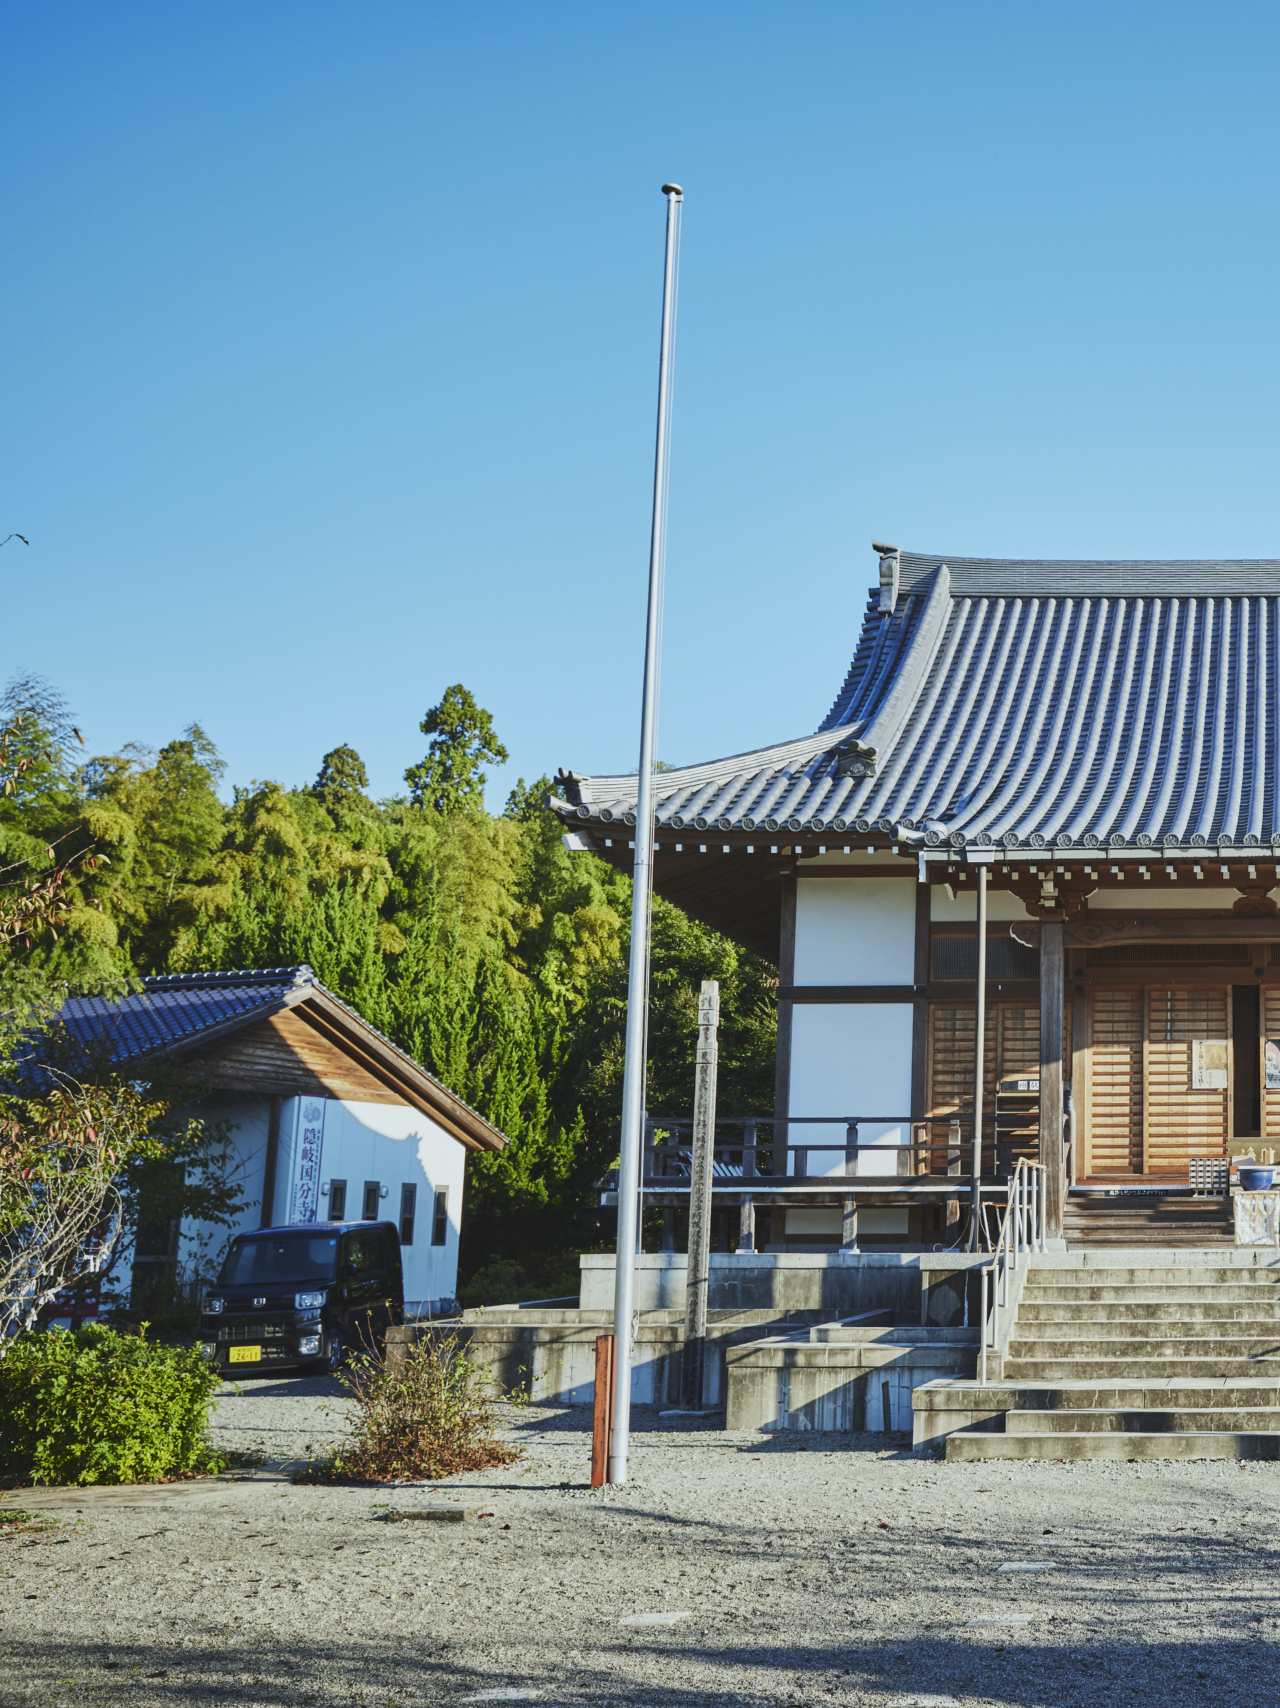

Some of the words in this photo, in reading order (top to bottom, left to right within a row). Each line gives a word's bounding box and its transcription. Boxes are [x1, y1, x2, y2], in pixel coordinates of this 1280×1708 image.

[296, 1128, 317, 1223] 隠岐国分寺
